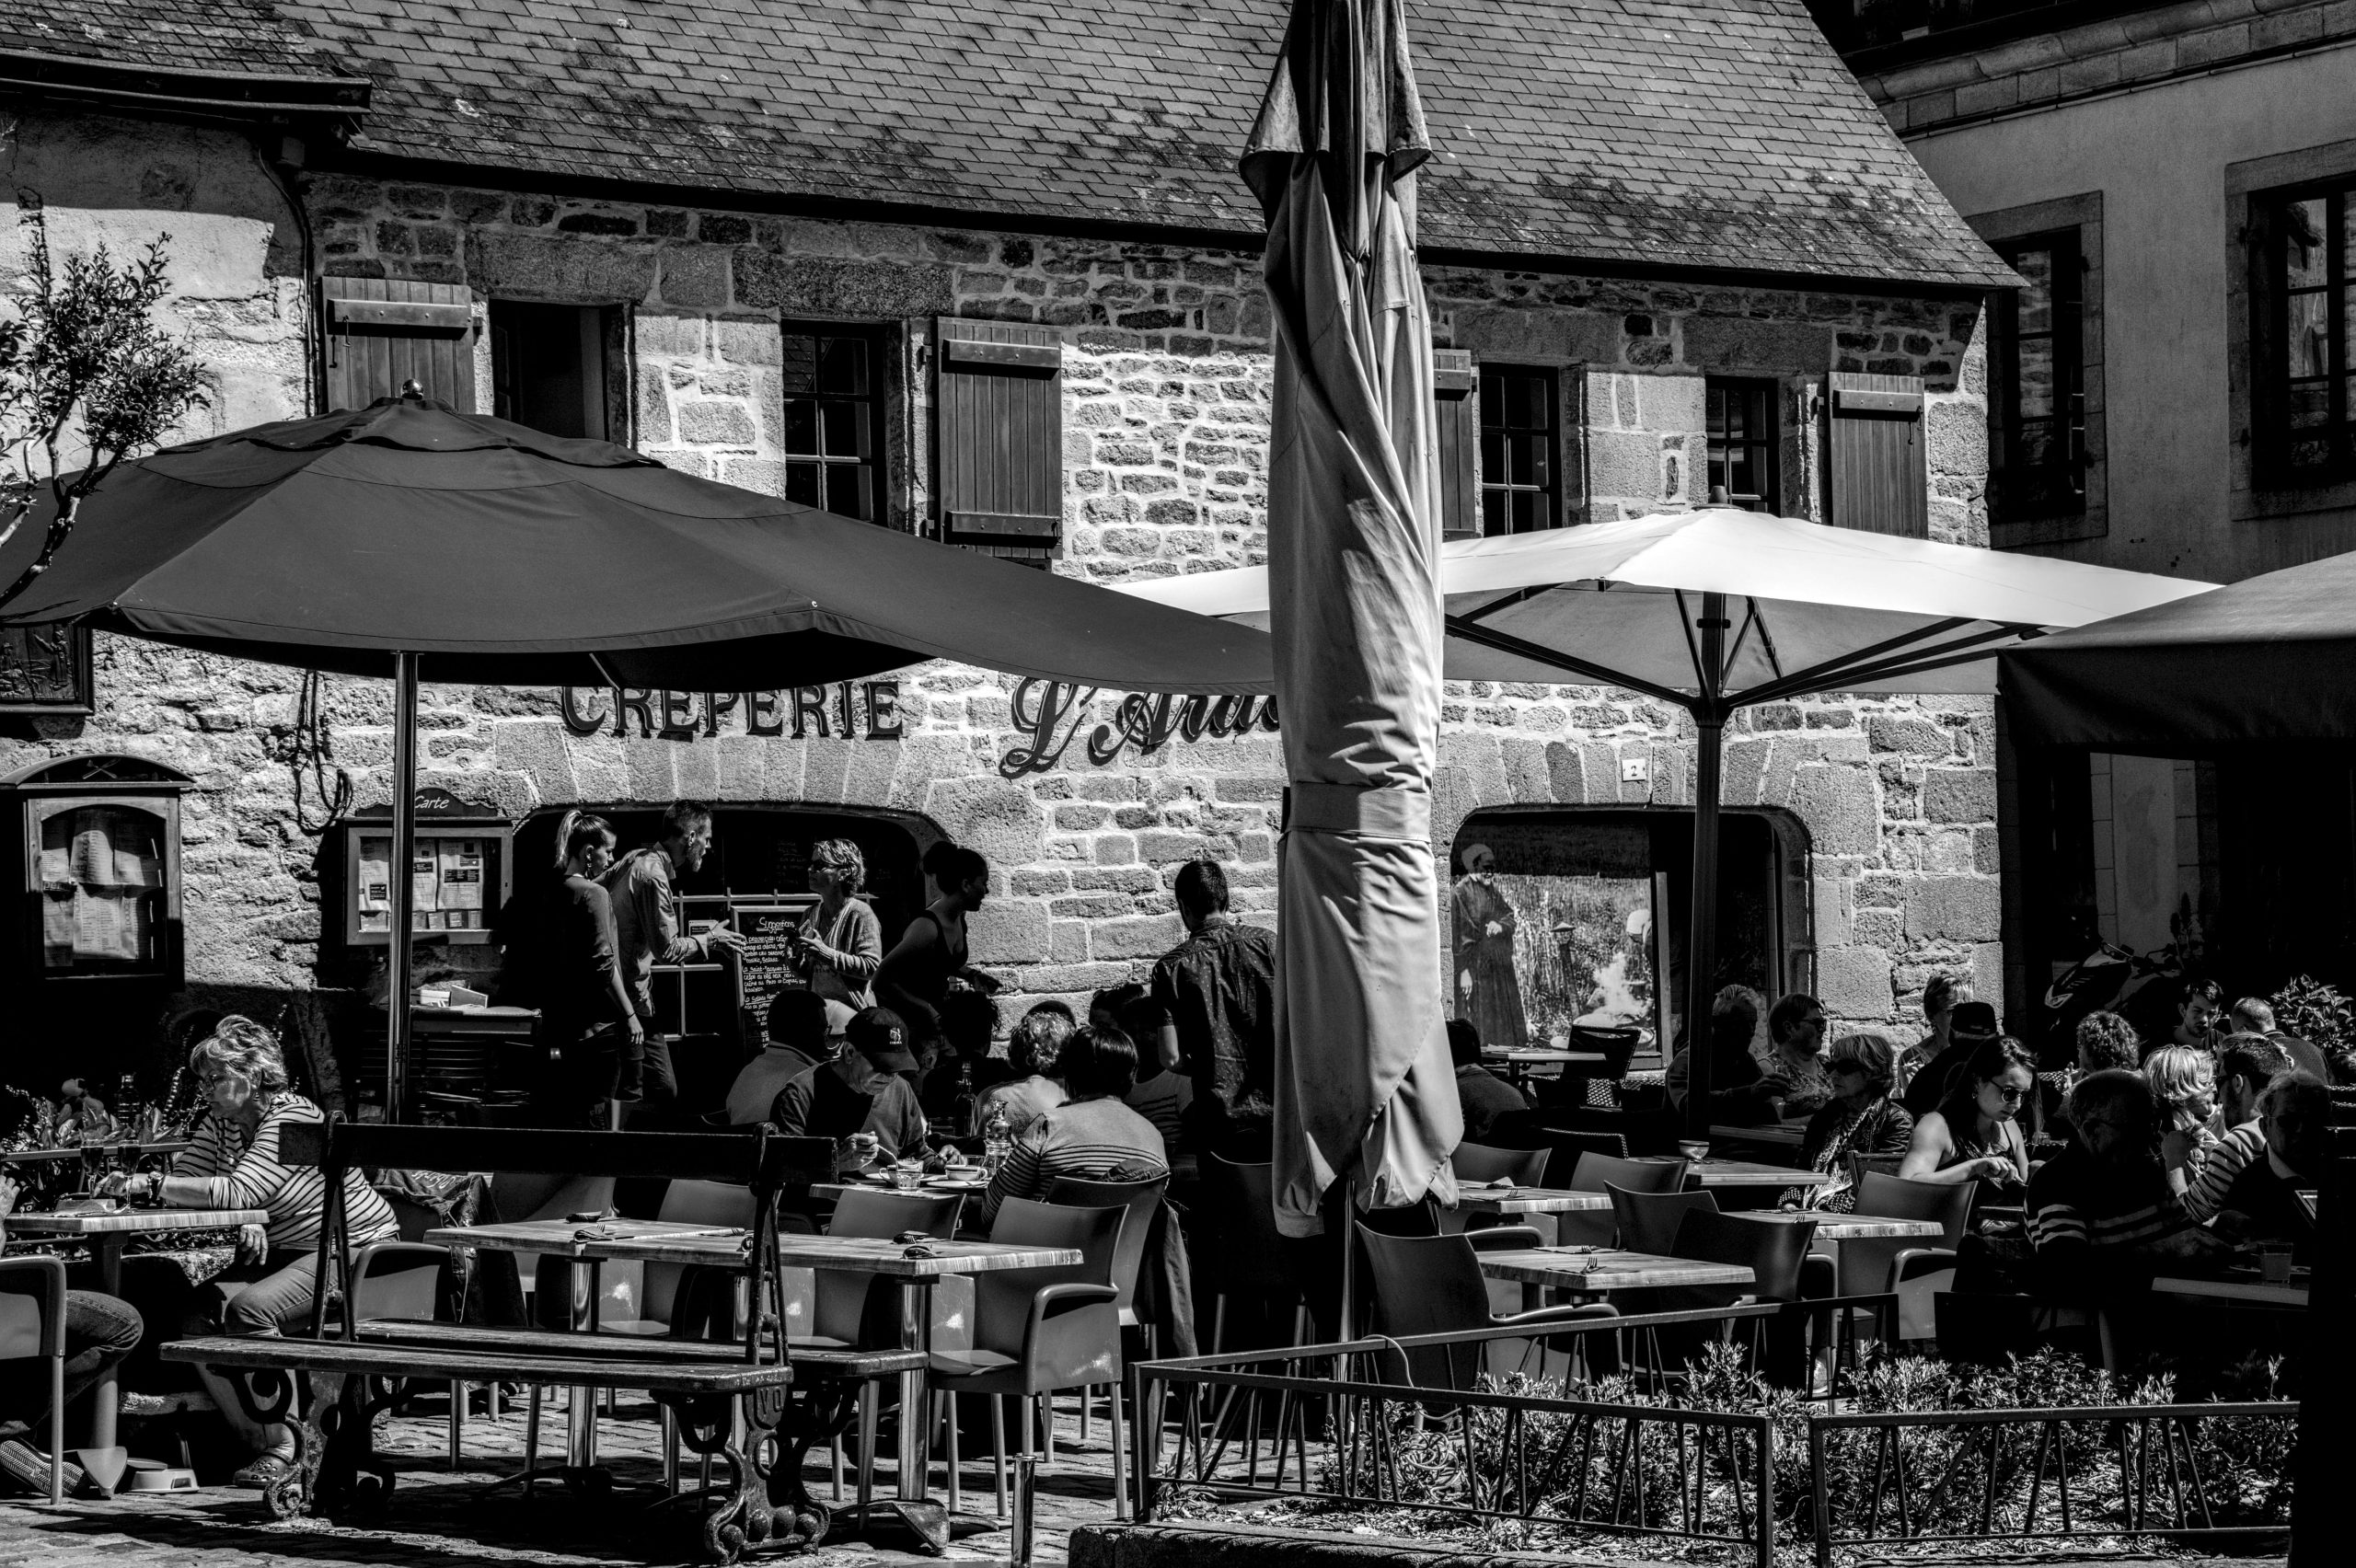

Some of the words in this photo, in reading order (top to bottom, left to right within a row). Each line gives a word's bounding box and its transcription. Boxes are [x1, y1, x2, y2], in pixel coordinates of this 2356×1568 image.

[1630, 765, 1638, 778] 2
[414, 794, 450, 810] Carte
[758, 917, 795, 934] Suggestions
